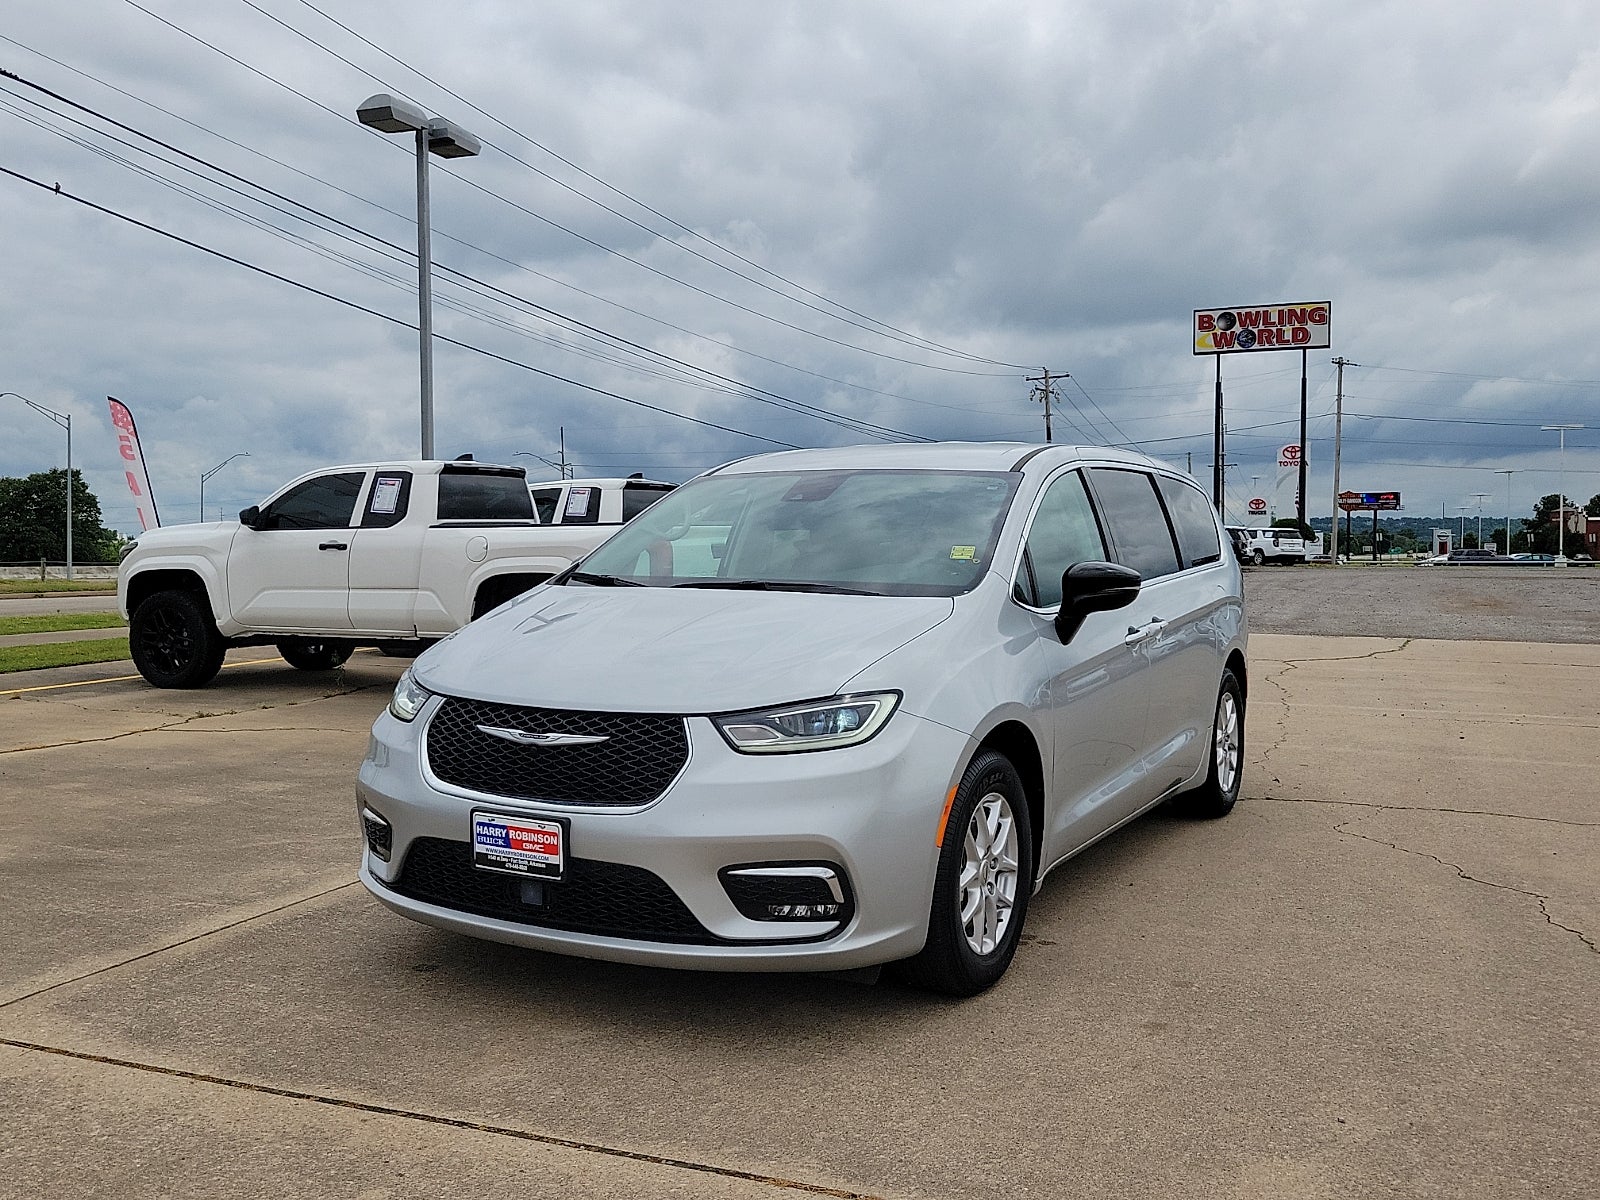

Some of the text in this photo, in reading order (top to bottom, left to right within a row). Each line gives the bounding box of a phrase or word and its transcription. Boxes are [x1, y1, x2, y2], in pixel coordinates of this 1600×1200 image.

[1198, 307, 1328, 332] BOWLING
[1212, 327, 1311, 349] WORLD
[476, 825, 558, 846] HARRY ROBINSON
[477, 835, 507, 846] BUICK
[522, 842, 545, 851] GMC
